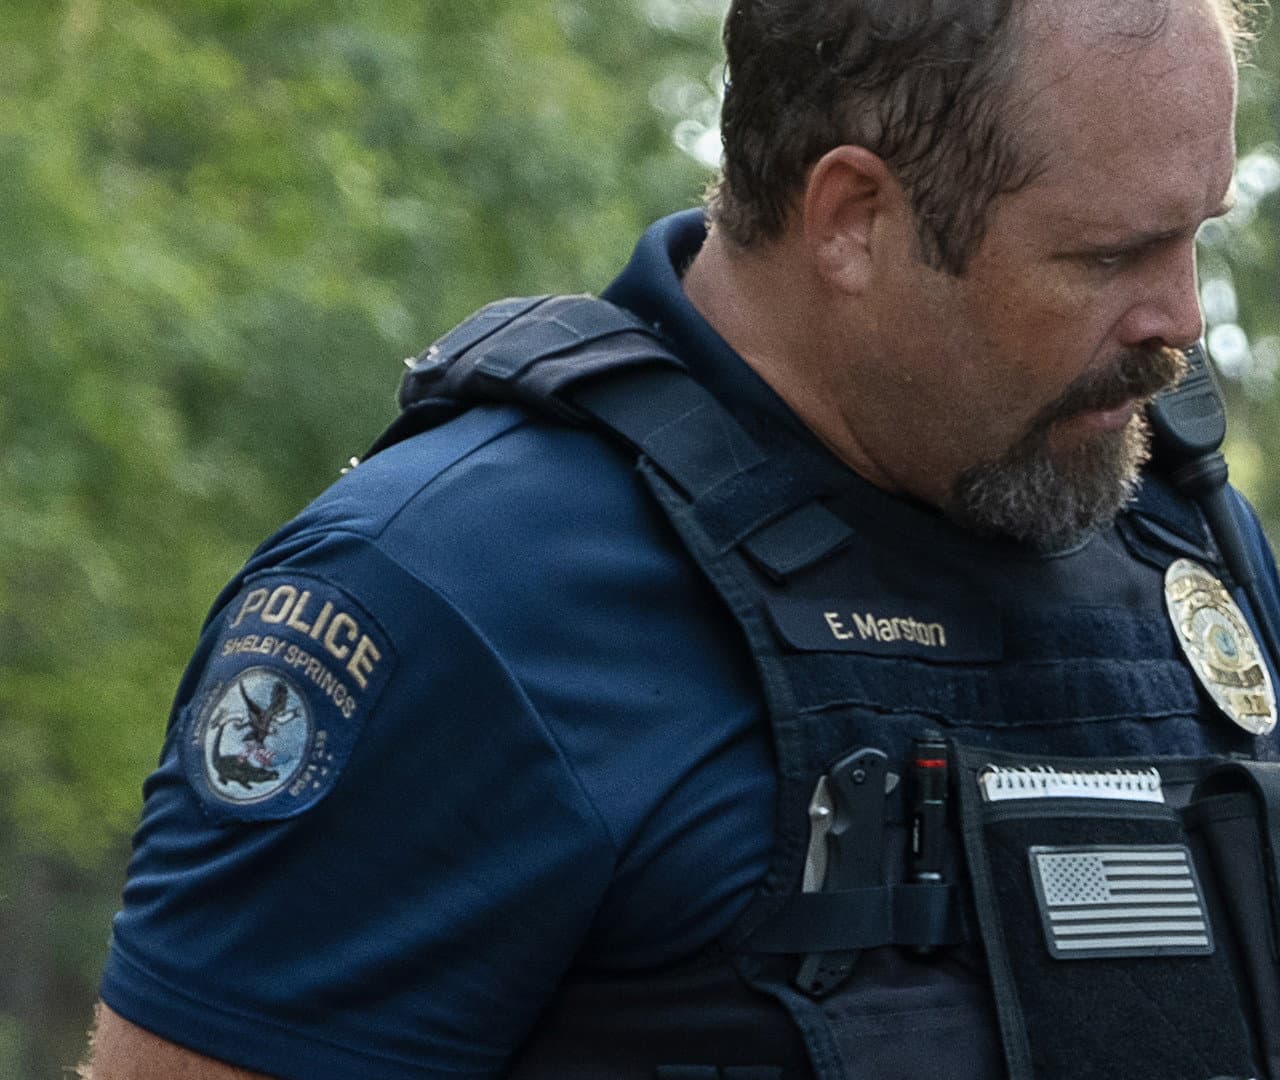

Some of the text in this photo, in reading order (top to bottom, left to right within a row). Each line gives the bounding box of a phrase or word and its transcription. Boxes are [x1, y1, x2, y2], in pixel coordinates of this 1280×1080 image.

[230, 584, 382, 689] POLICE
[852, 612, 947, 647] Marston
[221, 633, 358, 719] SHELBY SPRINGS
